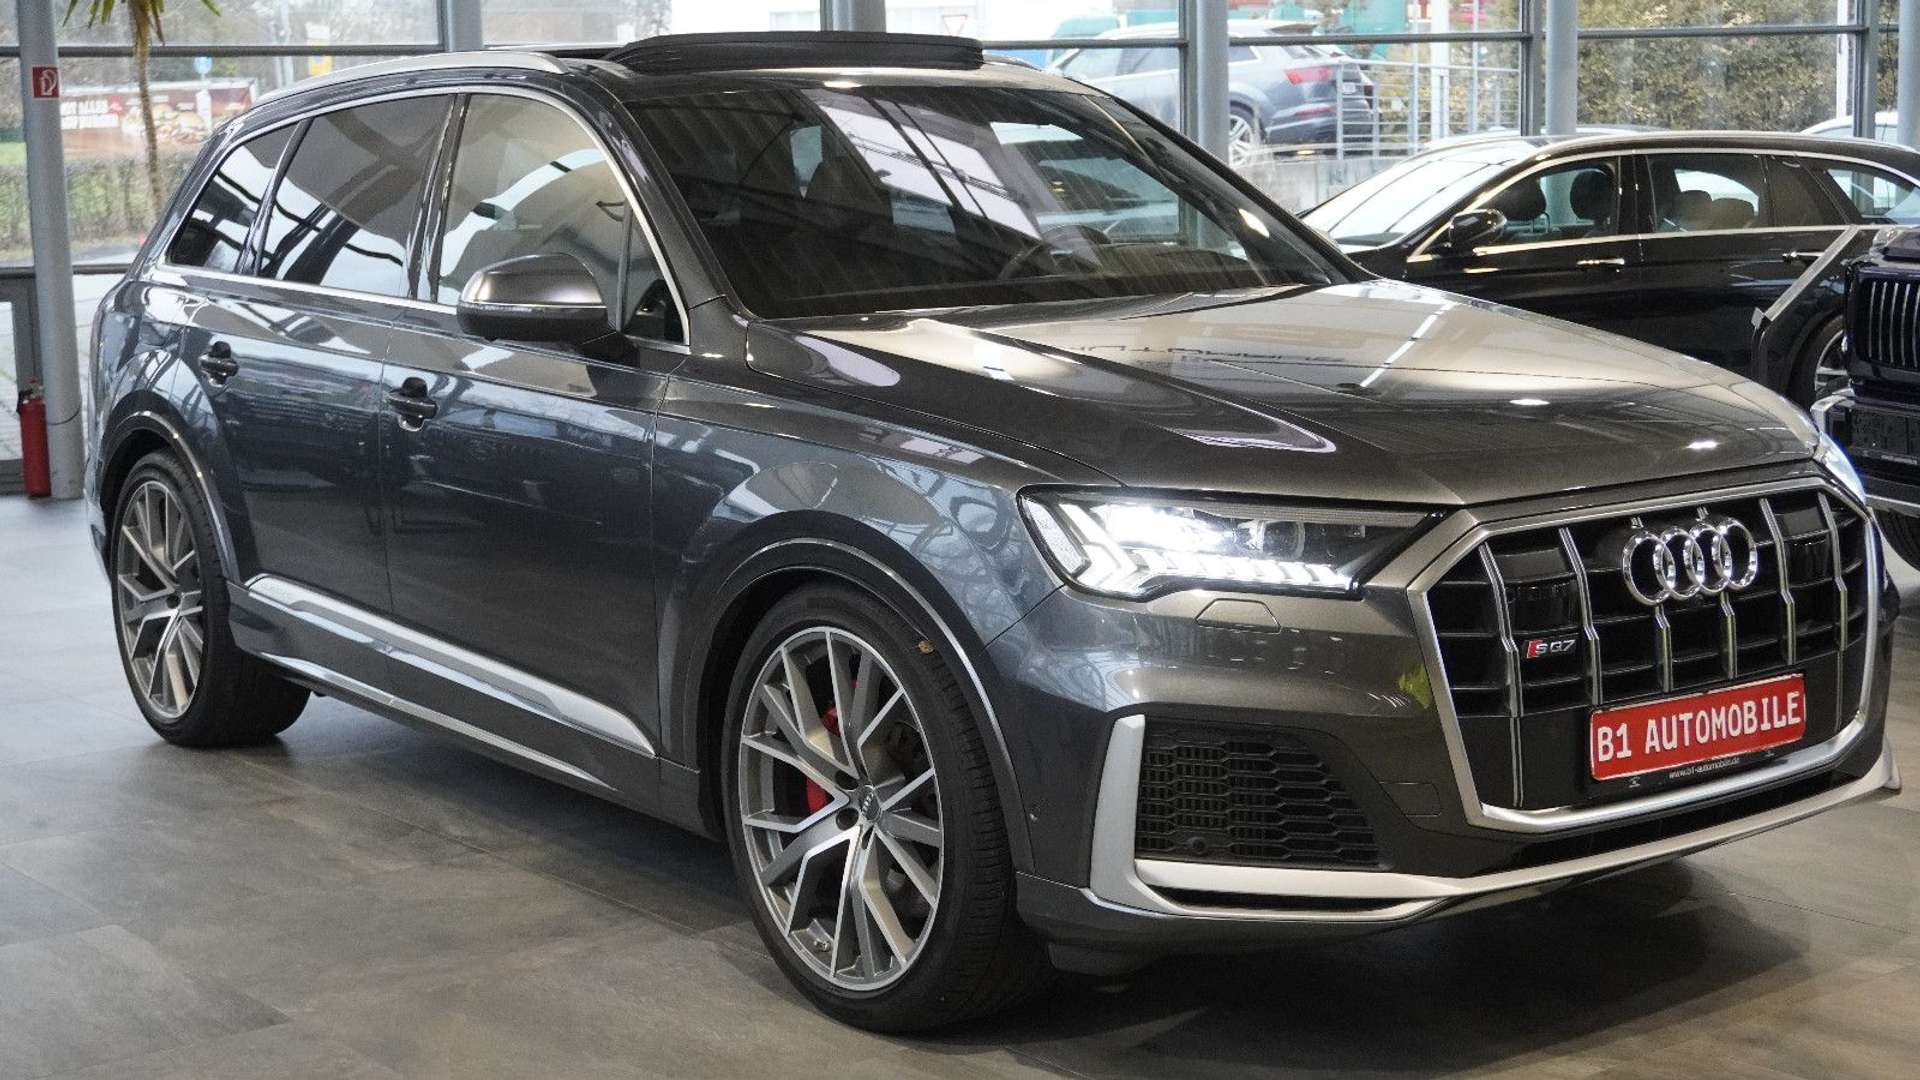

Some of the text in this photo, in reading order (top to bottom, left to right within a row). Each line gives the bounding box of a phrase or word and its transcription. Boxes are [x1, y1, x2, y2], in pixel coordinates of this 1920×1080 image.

[1533, 639, 1576, 655] SQ7
[1598, 692, 1801, 761] B1 AUTOMOBILE
